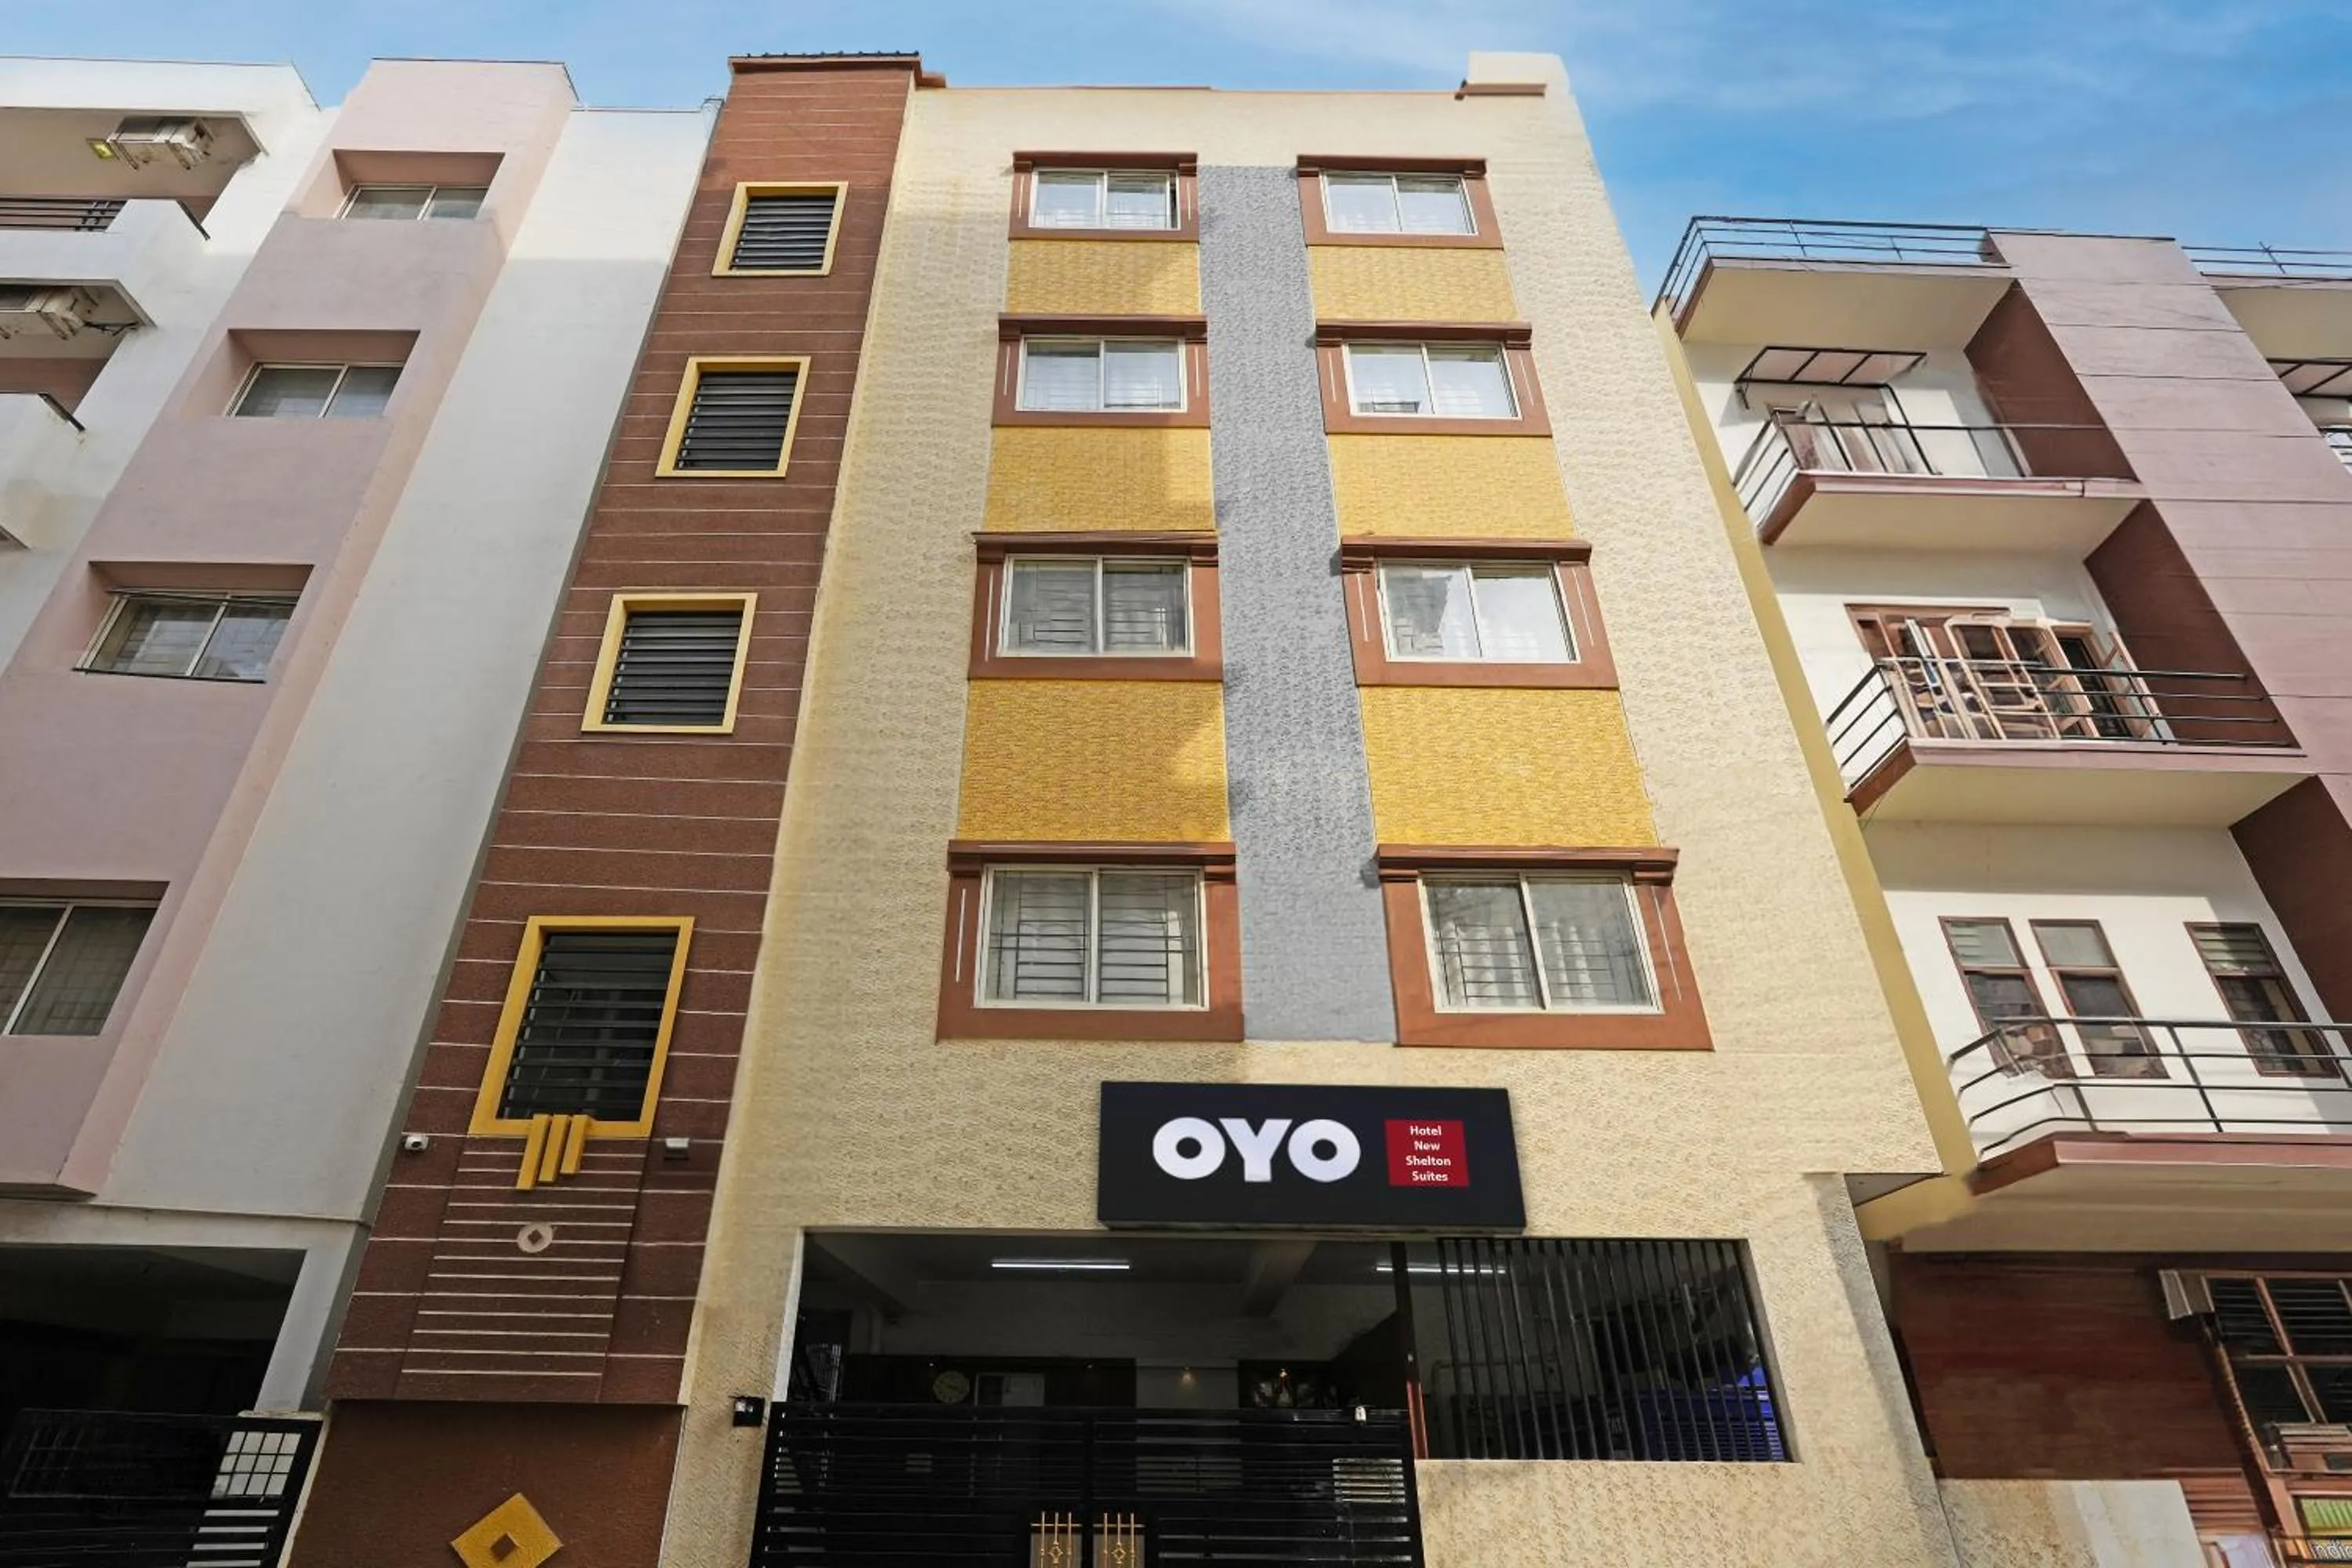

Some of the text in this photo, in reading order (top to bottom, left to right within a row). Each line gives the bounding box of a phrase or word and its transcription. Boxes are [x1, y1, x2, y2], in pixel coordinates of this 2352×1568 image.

[1410, 1125, 1442, 1136] Hotel
[1152, 1116, 1361, 1182] OYO
[1414, 1140, 1440, 1151] New
[1405, 1155, 1451, 1166] Shelton
[1411, 1171, 1449, 1181] Suites
